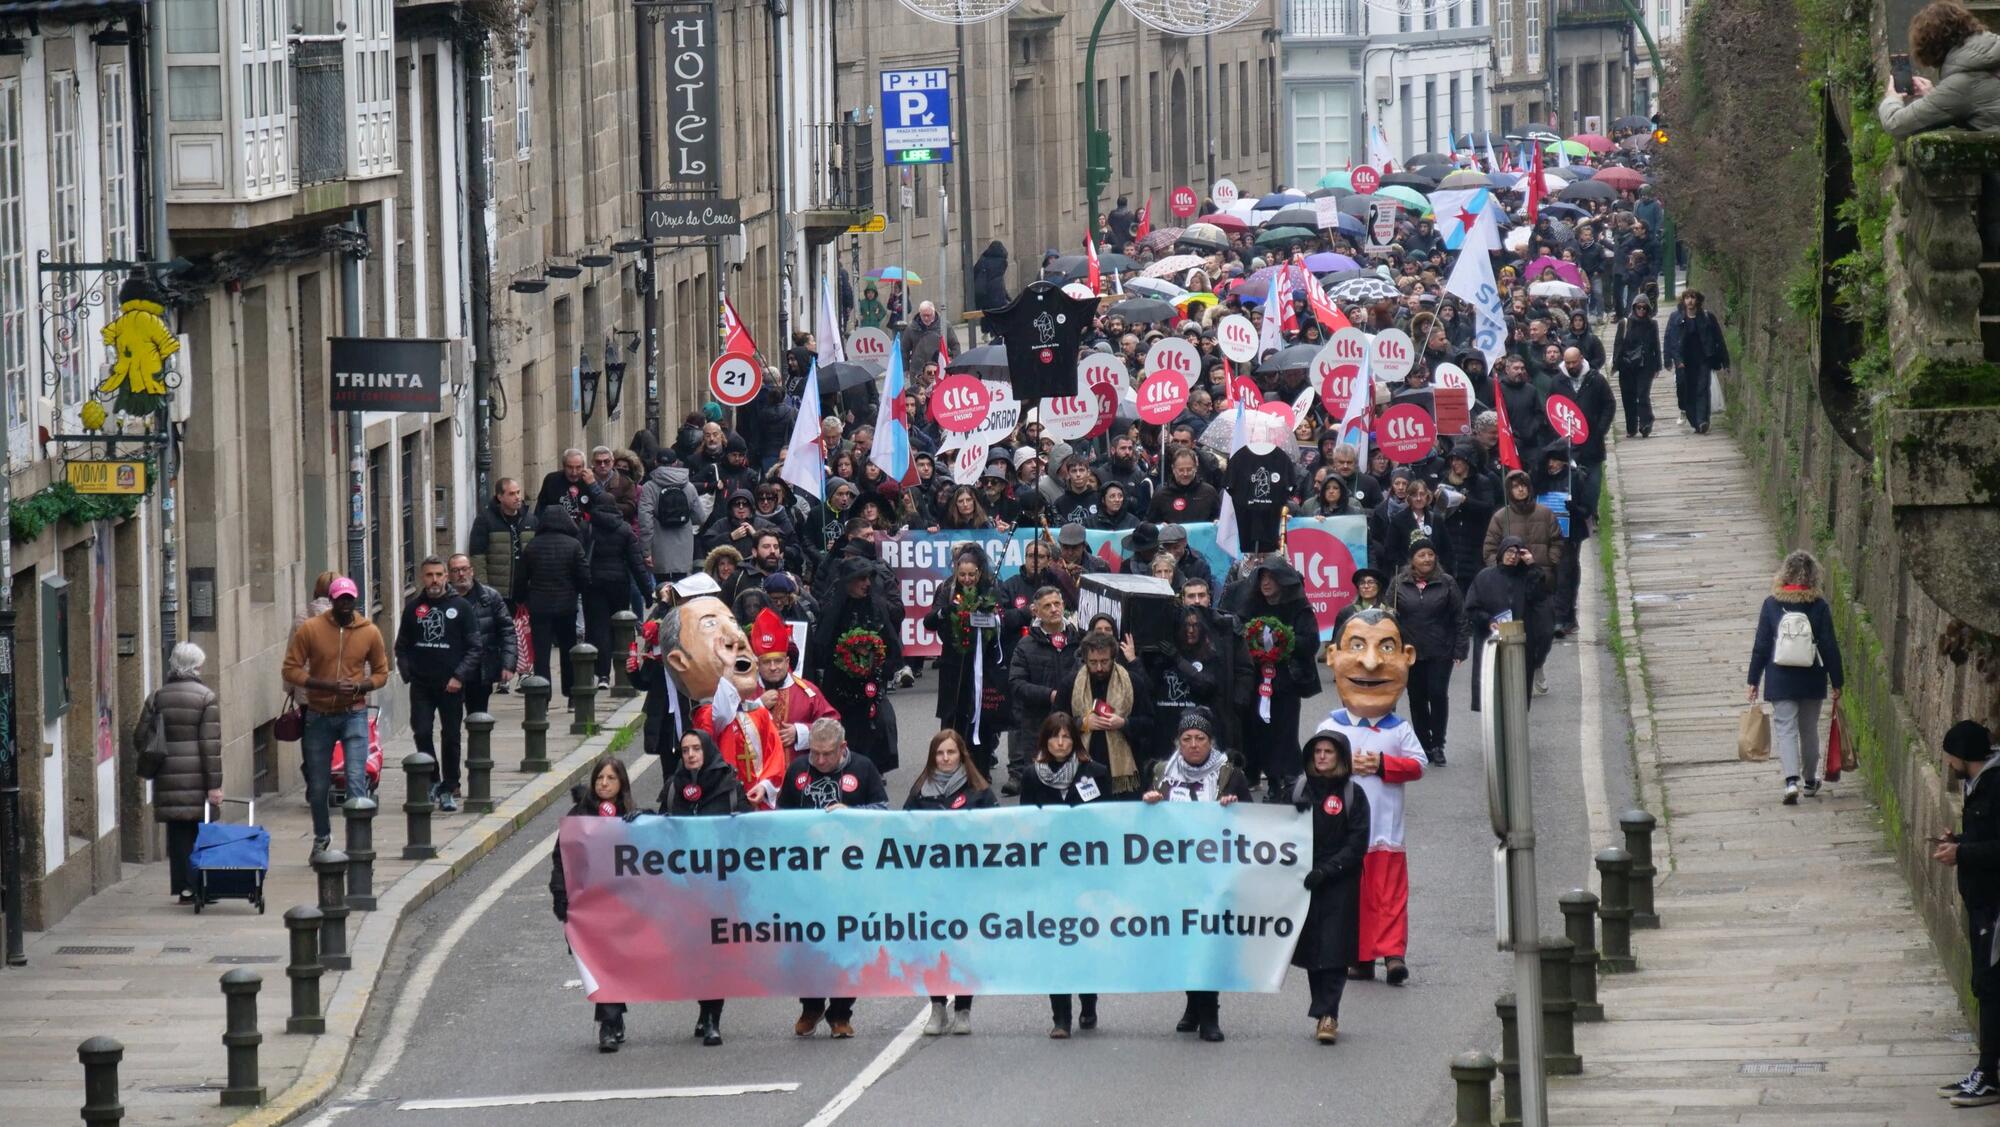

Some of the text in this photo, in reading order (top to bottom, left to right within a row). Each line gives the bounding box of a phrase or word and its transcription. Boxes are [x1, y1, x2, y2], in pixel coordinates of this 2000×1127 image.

[670, 19, 707, 175] HOTEL
[899, 91, 928, 127] P
[902, 149, 931, 162] LIBRE
[650, 207, 736, 229] Virxe da Cerca
[1226, 324, 1251, 344] CIG
[856, 337, 884, 354] CIG
[1336, 338, 1363, 358] CIG
[1378, 340, 1405, 359] CIG
[1157, 350, 1190, 371] CIG
[335, 373, 424, 388] TRINTA
[723, 370, 746, 386] 21
[1086, 366, 1119, 386] CIG
[943, 386, 979, 410] CIG
[1147, 381, 1179, 403] CIG
[1051, 395, 1087, 415] CIG
[1387, 416, 1425, 439] CIG
[961, 444, 982, 469] CIG
[73, 463, 108, 483] MOMO
[1294, 551, 1340, 589] IG
[613, 828, 1298, 881] Recuperar e Avanzar en Dereitos
[710, 908, 1294, 947] Ensino Público Galego con Futuro
